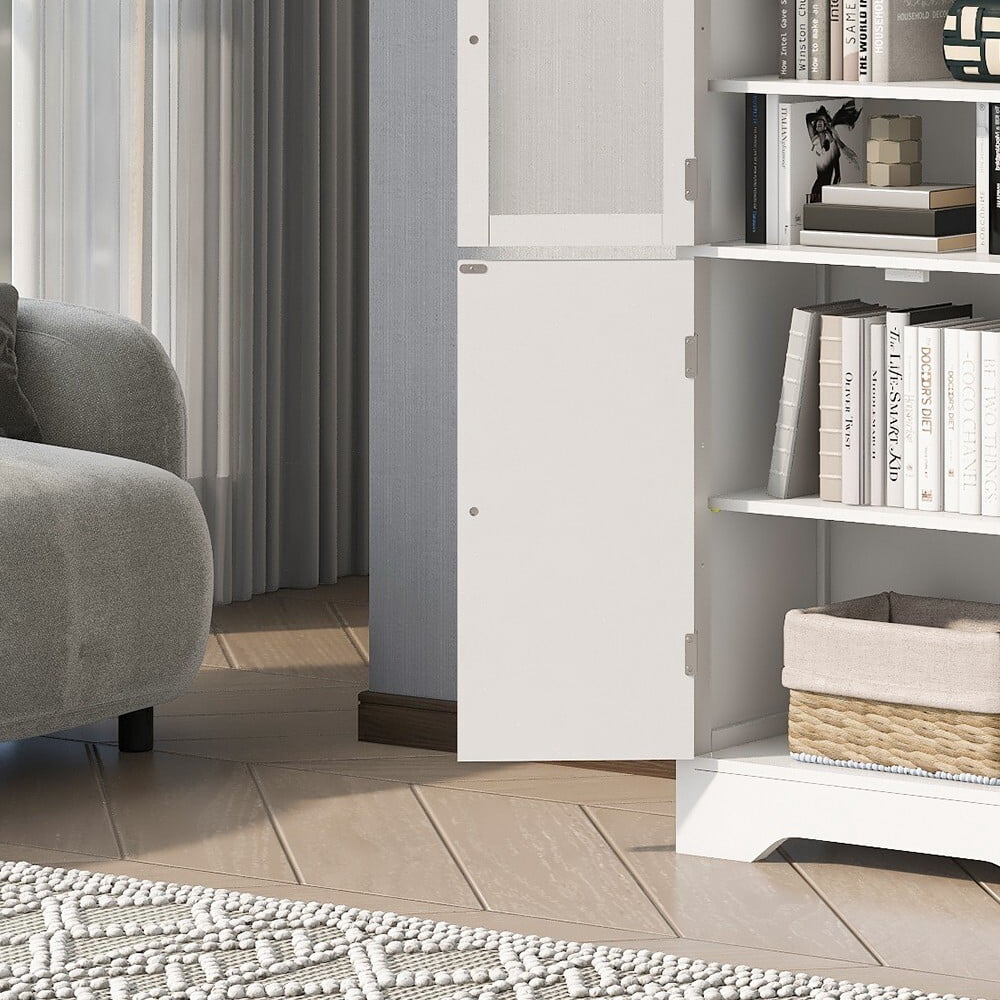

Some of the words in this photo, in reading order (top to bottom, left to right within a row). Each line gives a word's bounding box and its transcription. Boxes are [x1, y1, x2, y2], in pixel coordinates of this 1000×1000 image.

[812, 3, 819, 15] an
[811, 18, 819, 39] make
[845, 3, 857, 45] SAME
[859, 11, 868, 53] WORLD
[798, 23, 807, 72] Winston
[811, 43, 819, 53] to
[811, 56, 819, 73] How
[859, 55, 868, 75] THE
[983, 359, 997, 377] BE
[983, 383, 997, 426] TWO
[921, 408, 933, 435] DIET
[962, 418, 977, 491] CHANEL
[984, 431, 998, 504] THINGS
